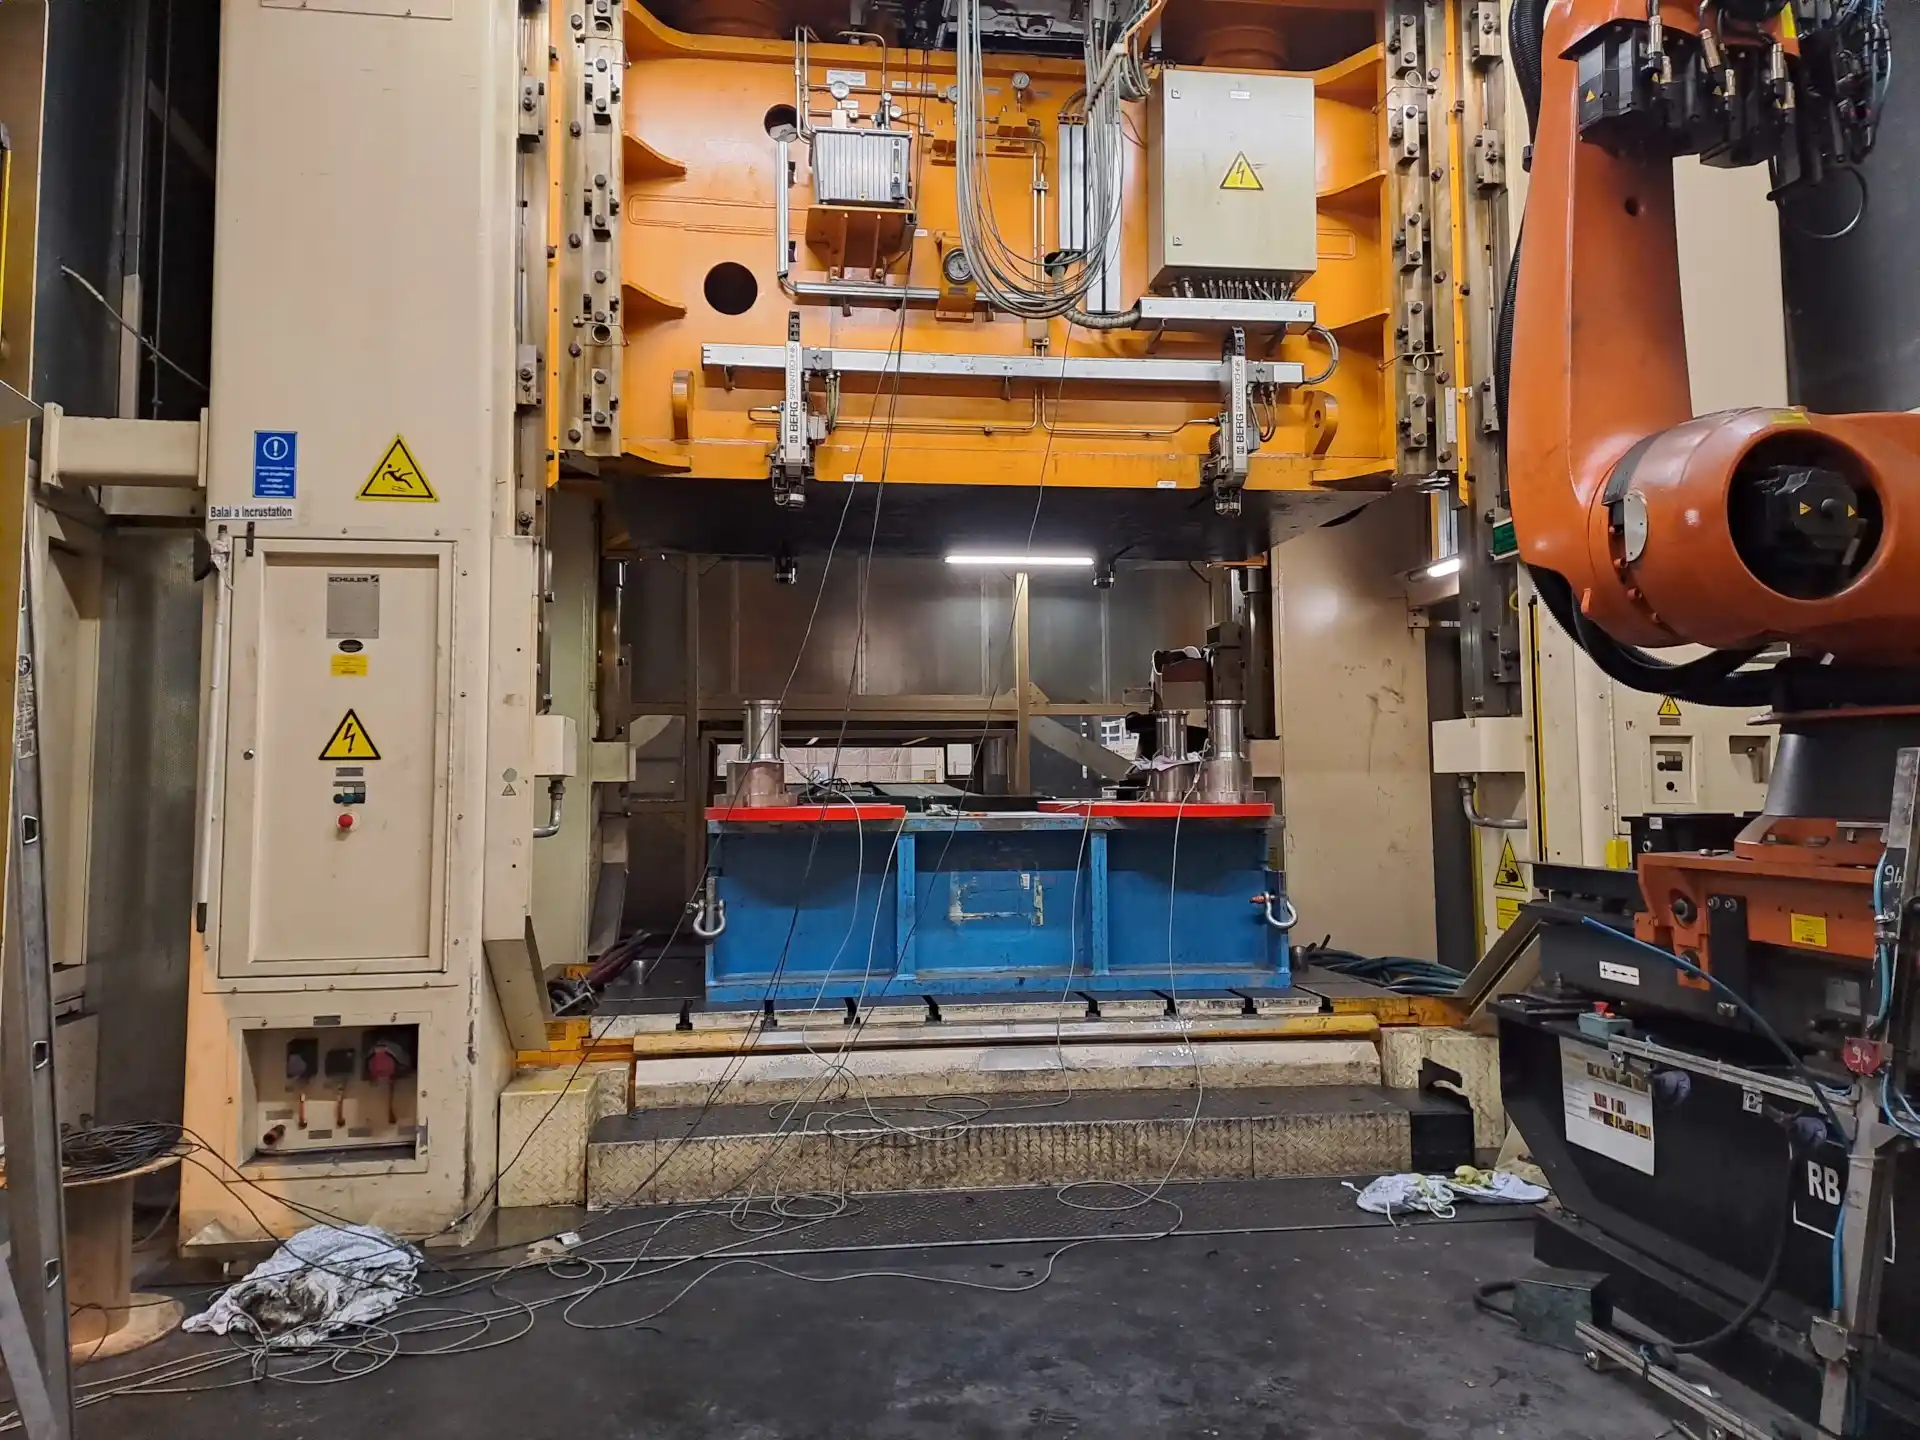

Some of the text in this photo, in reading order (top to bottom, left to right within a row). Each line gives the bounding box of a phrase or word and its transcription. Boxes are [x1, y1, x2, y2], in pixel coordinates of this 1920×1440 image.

[789, 401, 799, 432] BERG
[1236, 413, 1245, 443] BERG
[210, 506, 232, 518] Balai
[1884, 864, 1904, 889] 94
